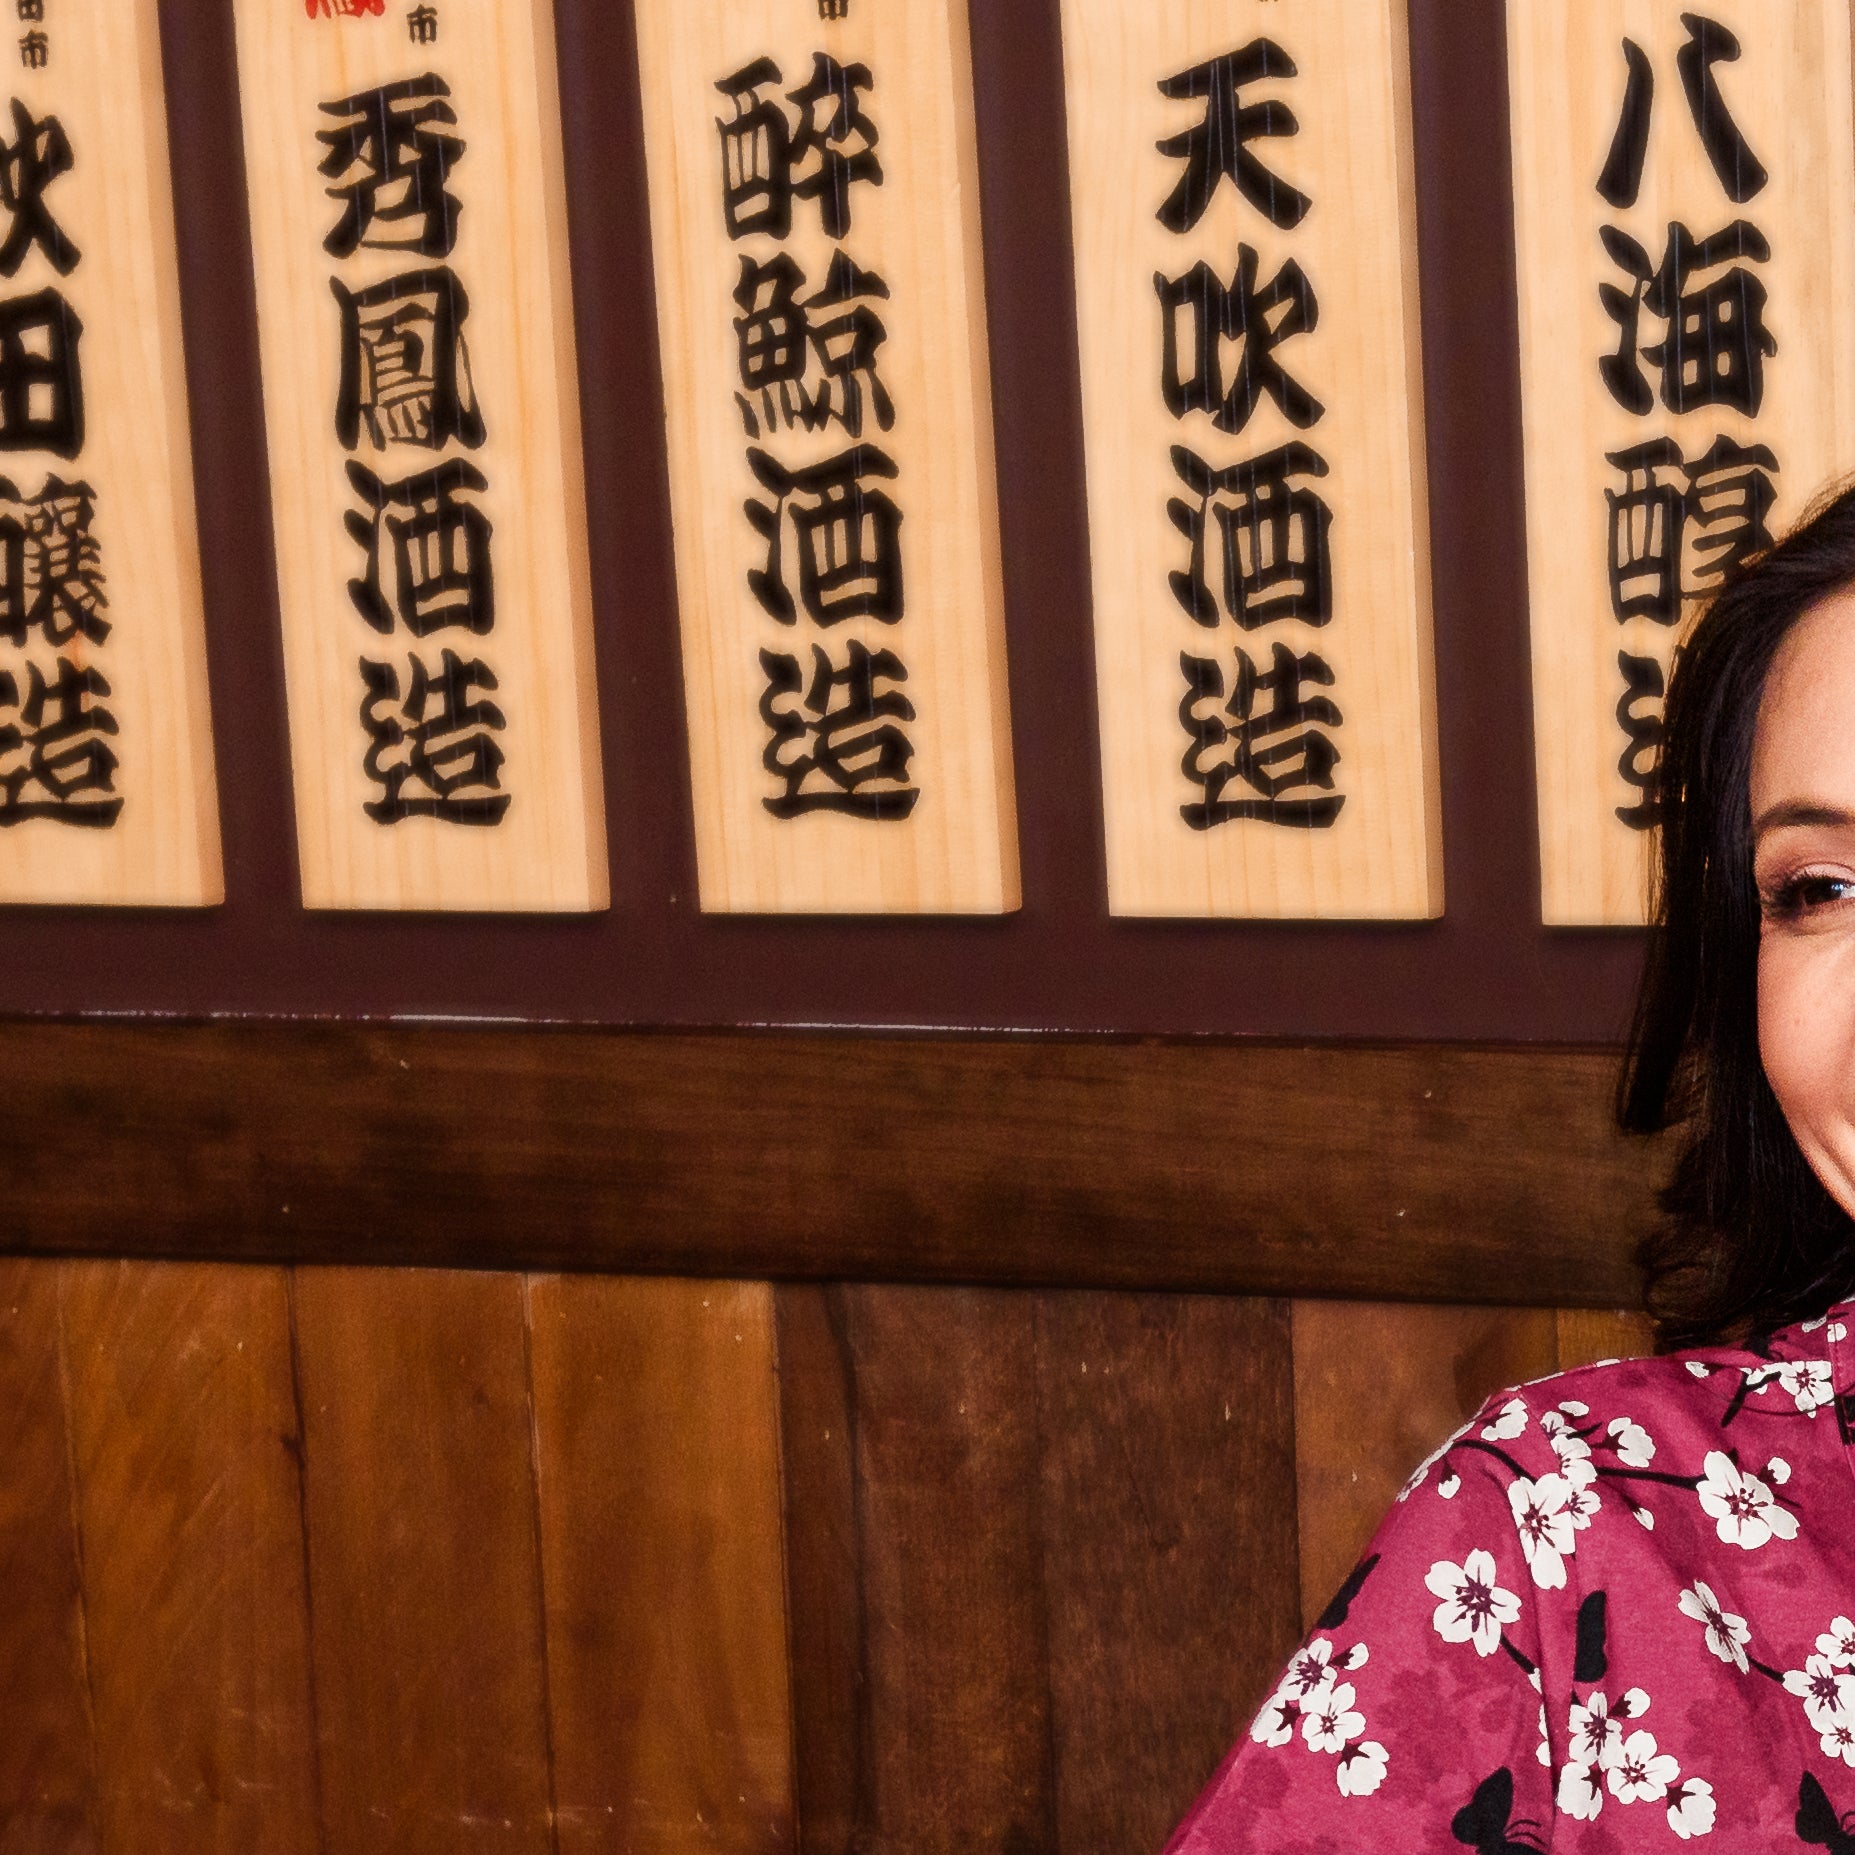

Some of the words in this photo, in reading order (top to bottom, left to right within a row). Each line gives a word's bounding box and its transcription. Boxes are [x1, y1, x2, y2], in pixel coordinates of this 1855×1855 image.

[406, 4, 438, 44] 市
[315, 72, 512, 827] 秀鳳酒造
[1154, 37, 1346, 832] 天吹酒造
